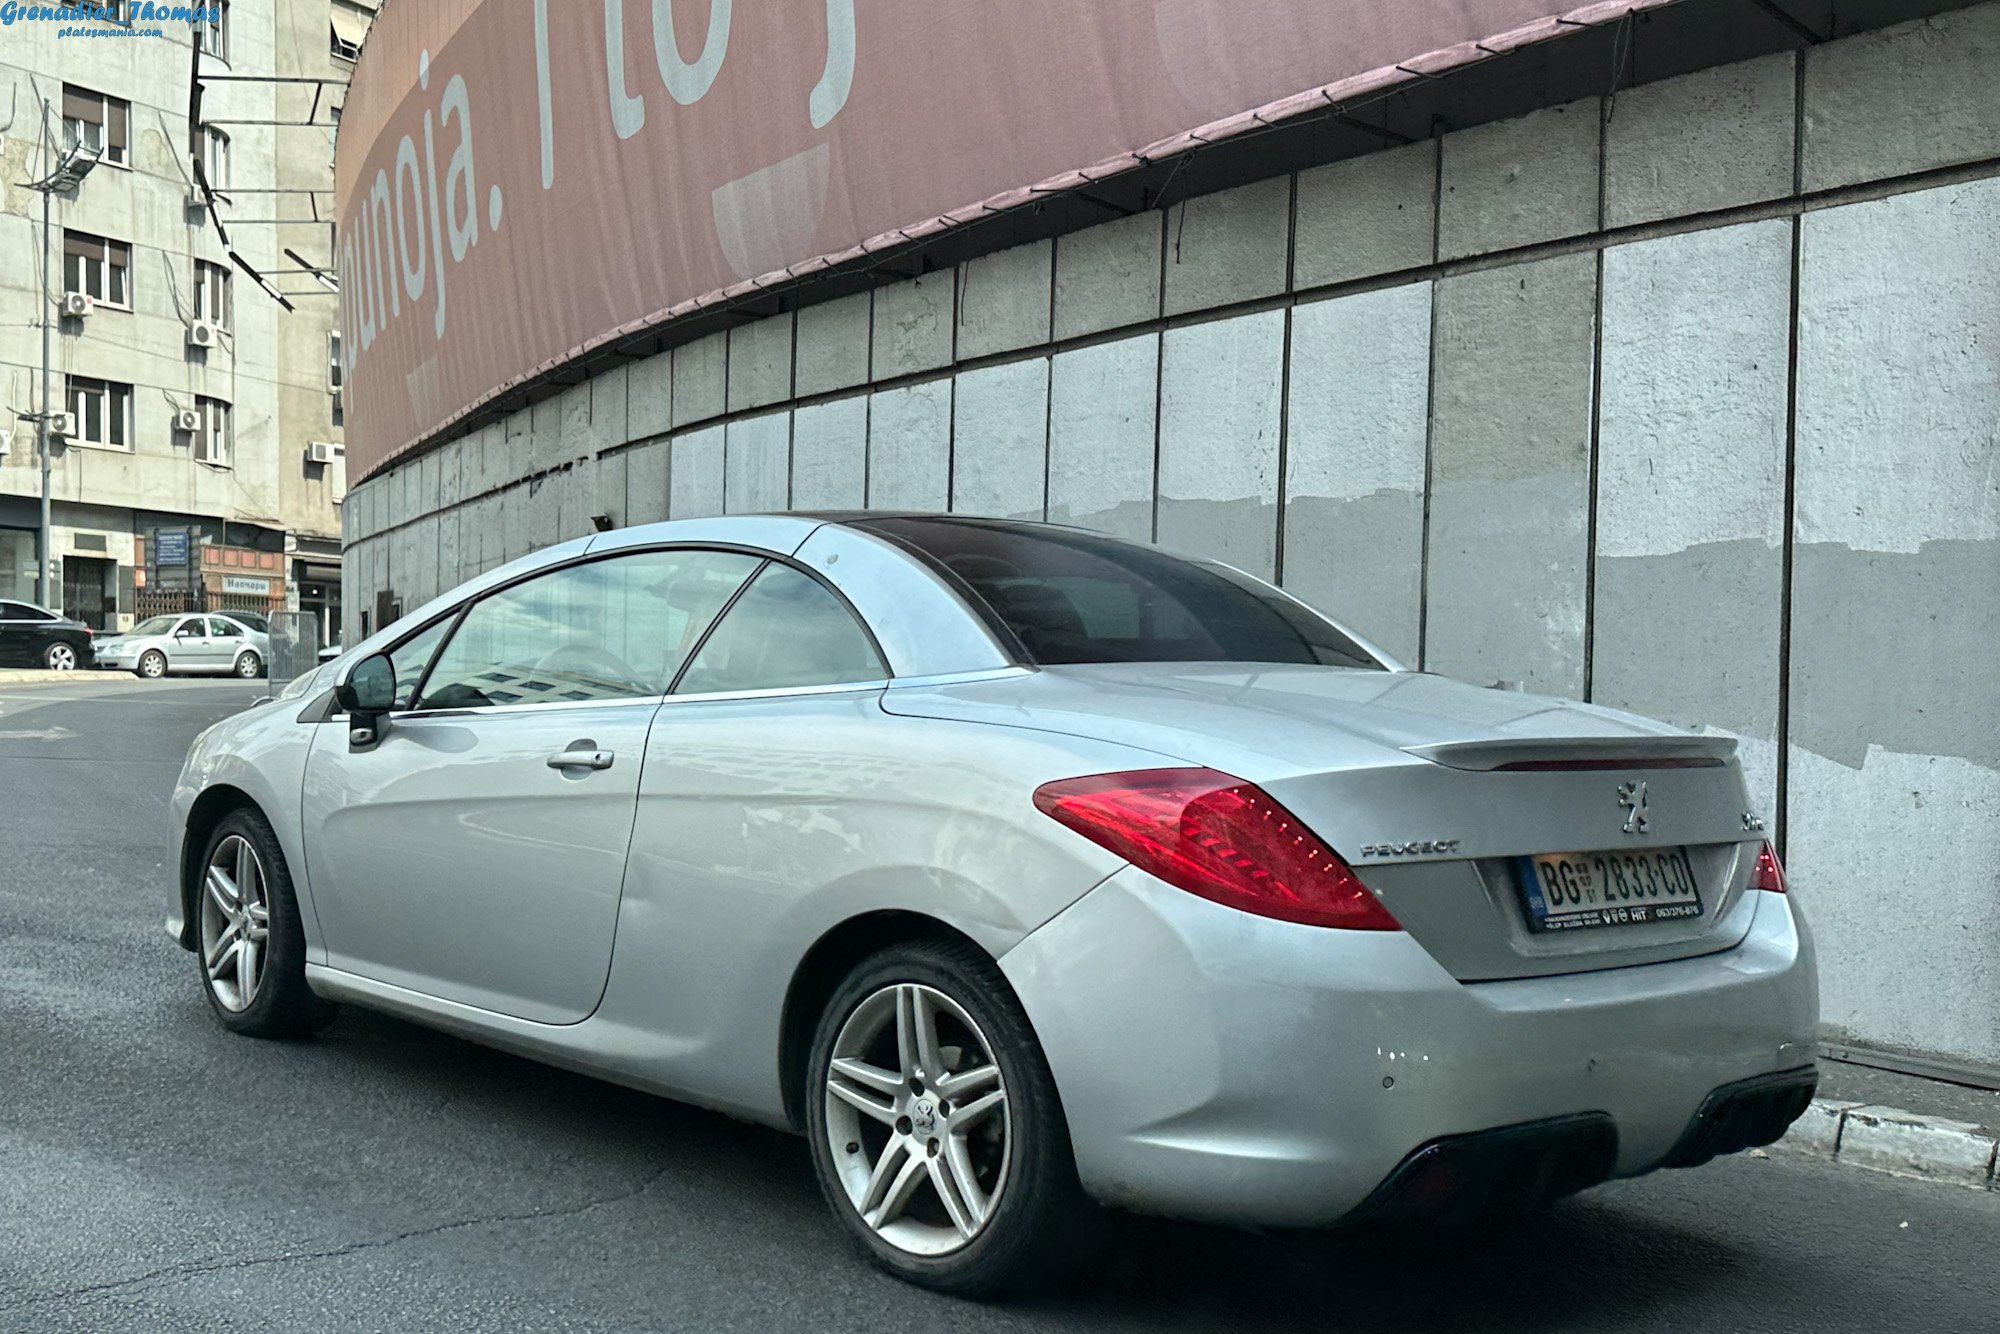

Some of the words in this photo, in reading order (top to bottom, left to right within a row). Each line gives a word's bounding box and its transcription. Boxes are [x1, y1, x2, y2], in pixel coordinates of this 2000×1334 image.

[1360, 839, 1460, 857] PEUGEOT
[1540, 860, 1581, 906] BG
[1631, 909, 1647, 922] HIT
